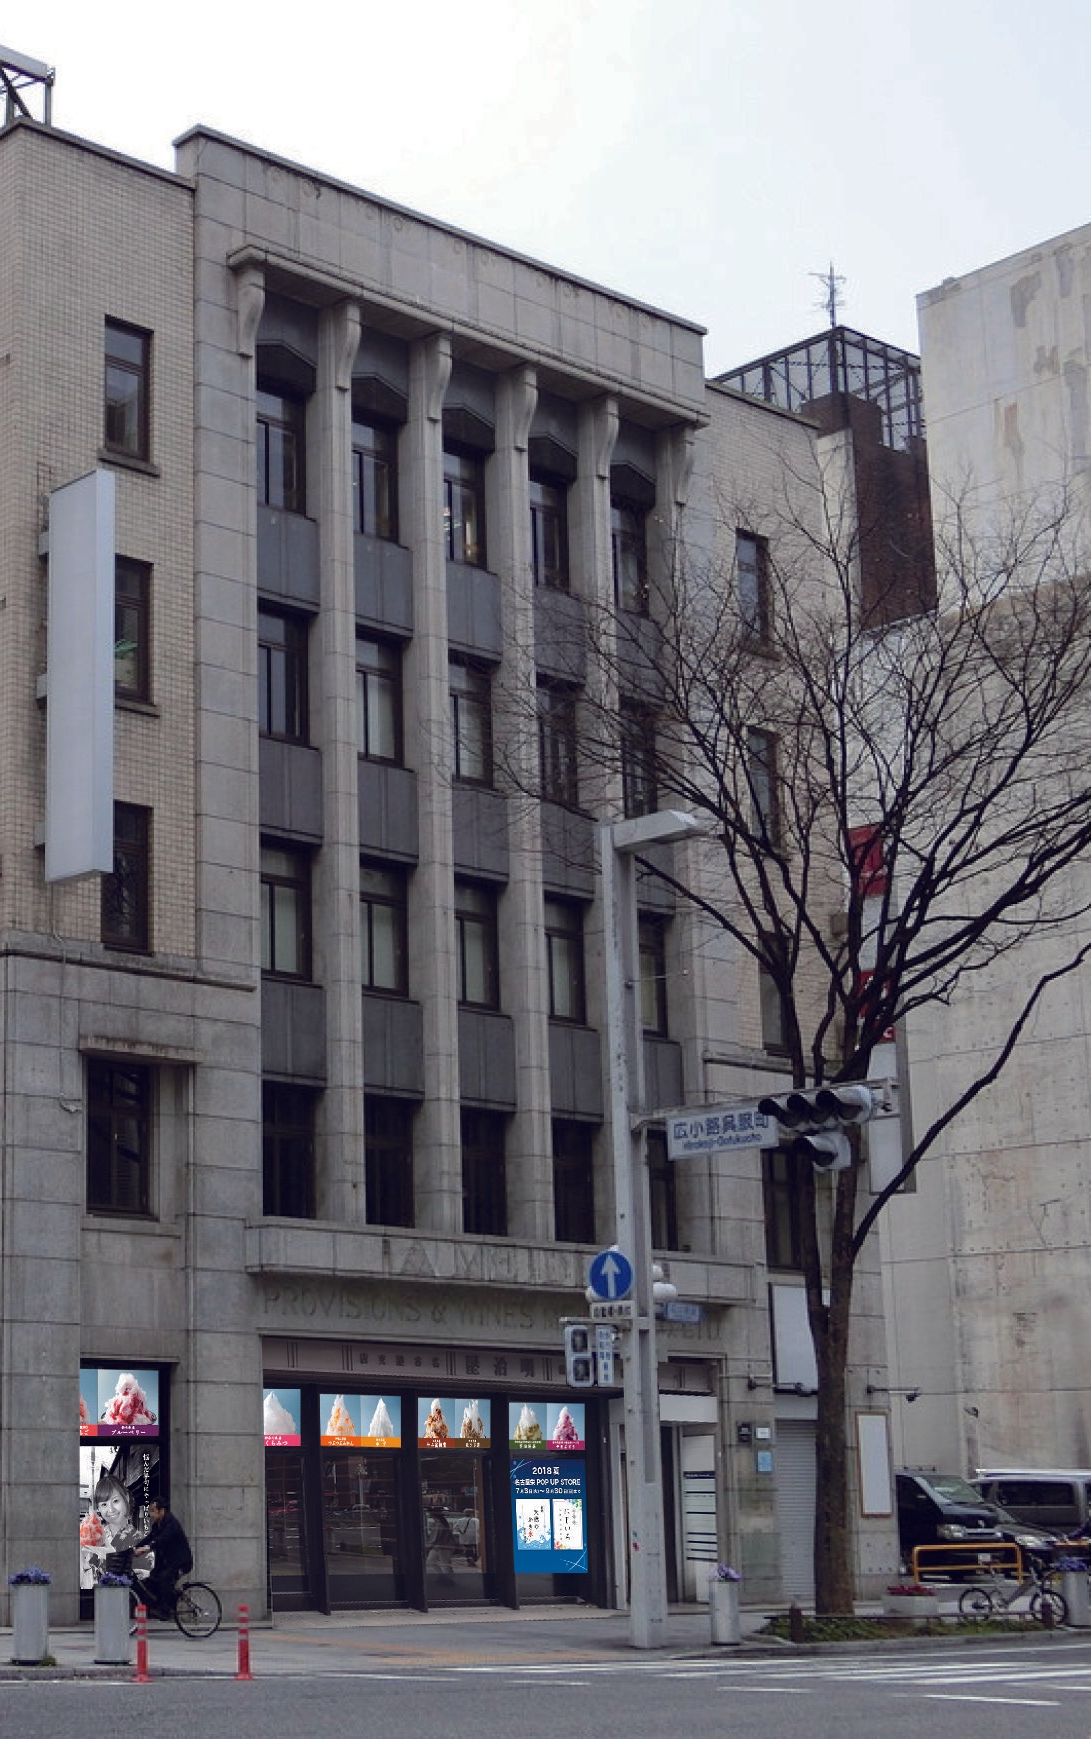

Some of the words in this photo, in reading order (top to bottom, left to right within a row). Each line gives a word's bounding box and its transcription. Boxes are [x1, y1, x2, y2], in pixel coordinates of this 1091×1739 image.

[536, 1478, 549, 1486] POP
[549, 1478, 560, 1486] UP
[560, 1478, 581, 1486] STORE
